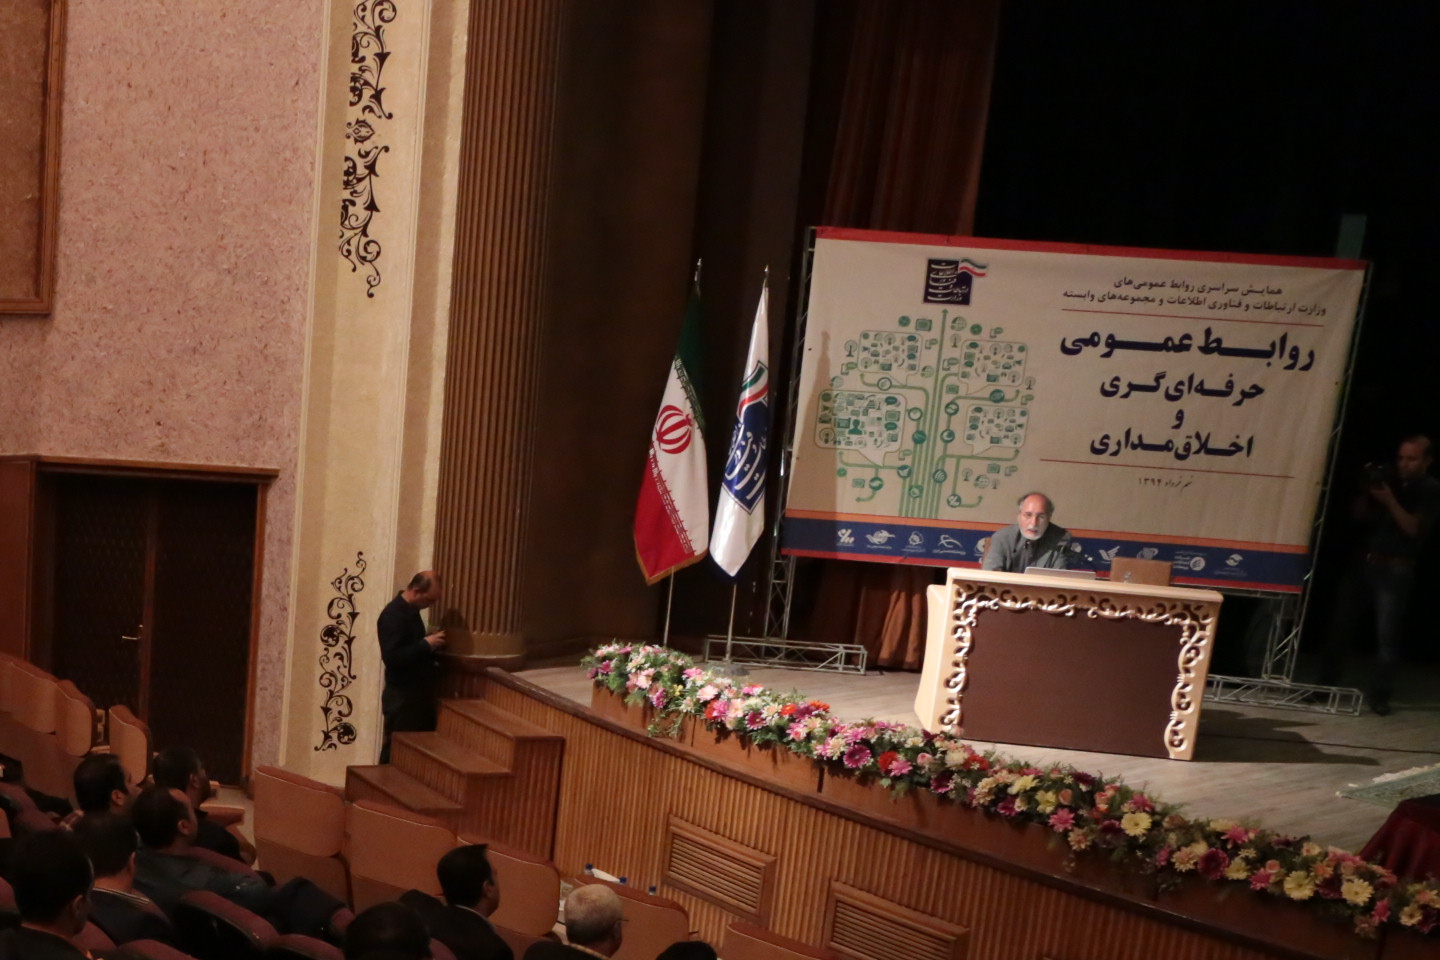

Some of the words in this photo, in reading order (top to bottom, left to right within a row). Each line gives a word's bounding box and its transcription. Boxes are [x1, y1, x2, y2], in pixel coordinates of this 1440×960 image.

[1169, 278, 1195, 292] روابط
[1197, 282, 1240, 294] سراسری
[1241, 283, 1283, 296] همایش
[1062, 289, 1096, 301] وابسته
[1166, 294, 1206, 306] اطلاعات
[1158, 298, 1164, 306] و
[1207, 298, 1243, 311] فناوری
[1244, 303, 1250, 311] و
[1252, 299, 1296, 313] ارتباطات
[1297, 302, 1327, 316] وزارت
[1059, 331, 1194, 359] عمومی
[1197, 326, 1315, 372] روابط
[1171, 408, 1185, 430] و
